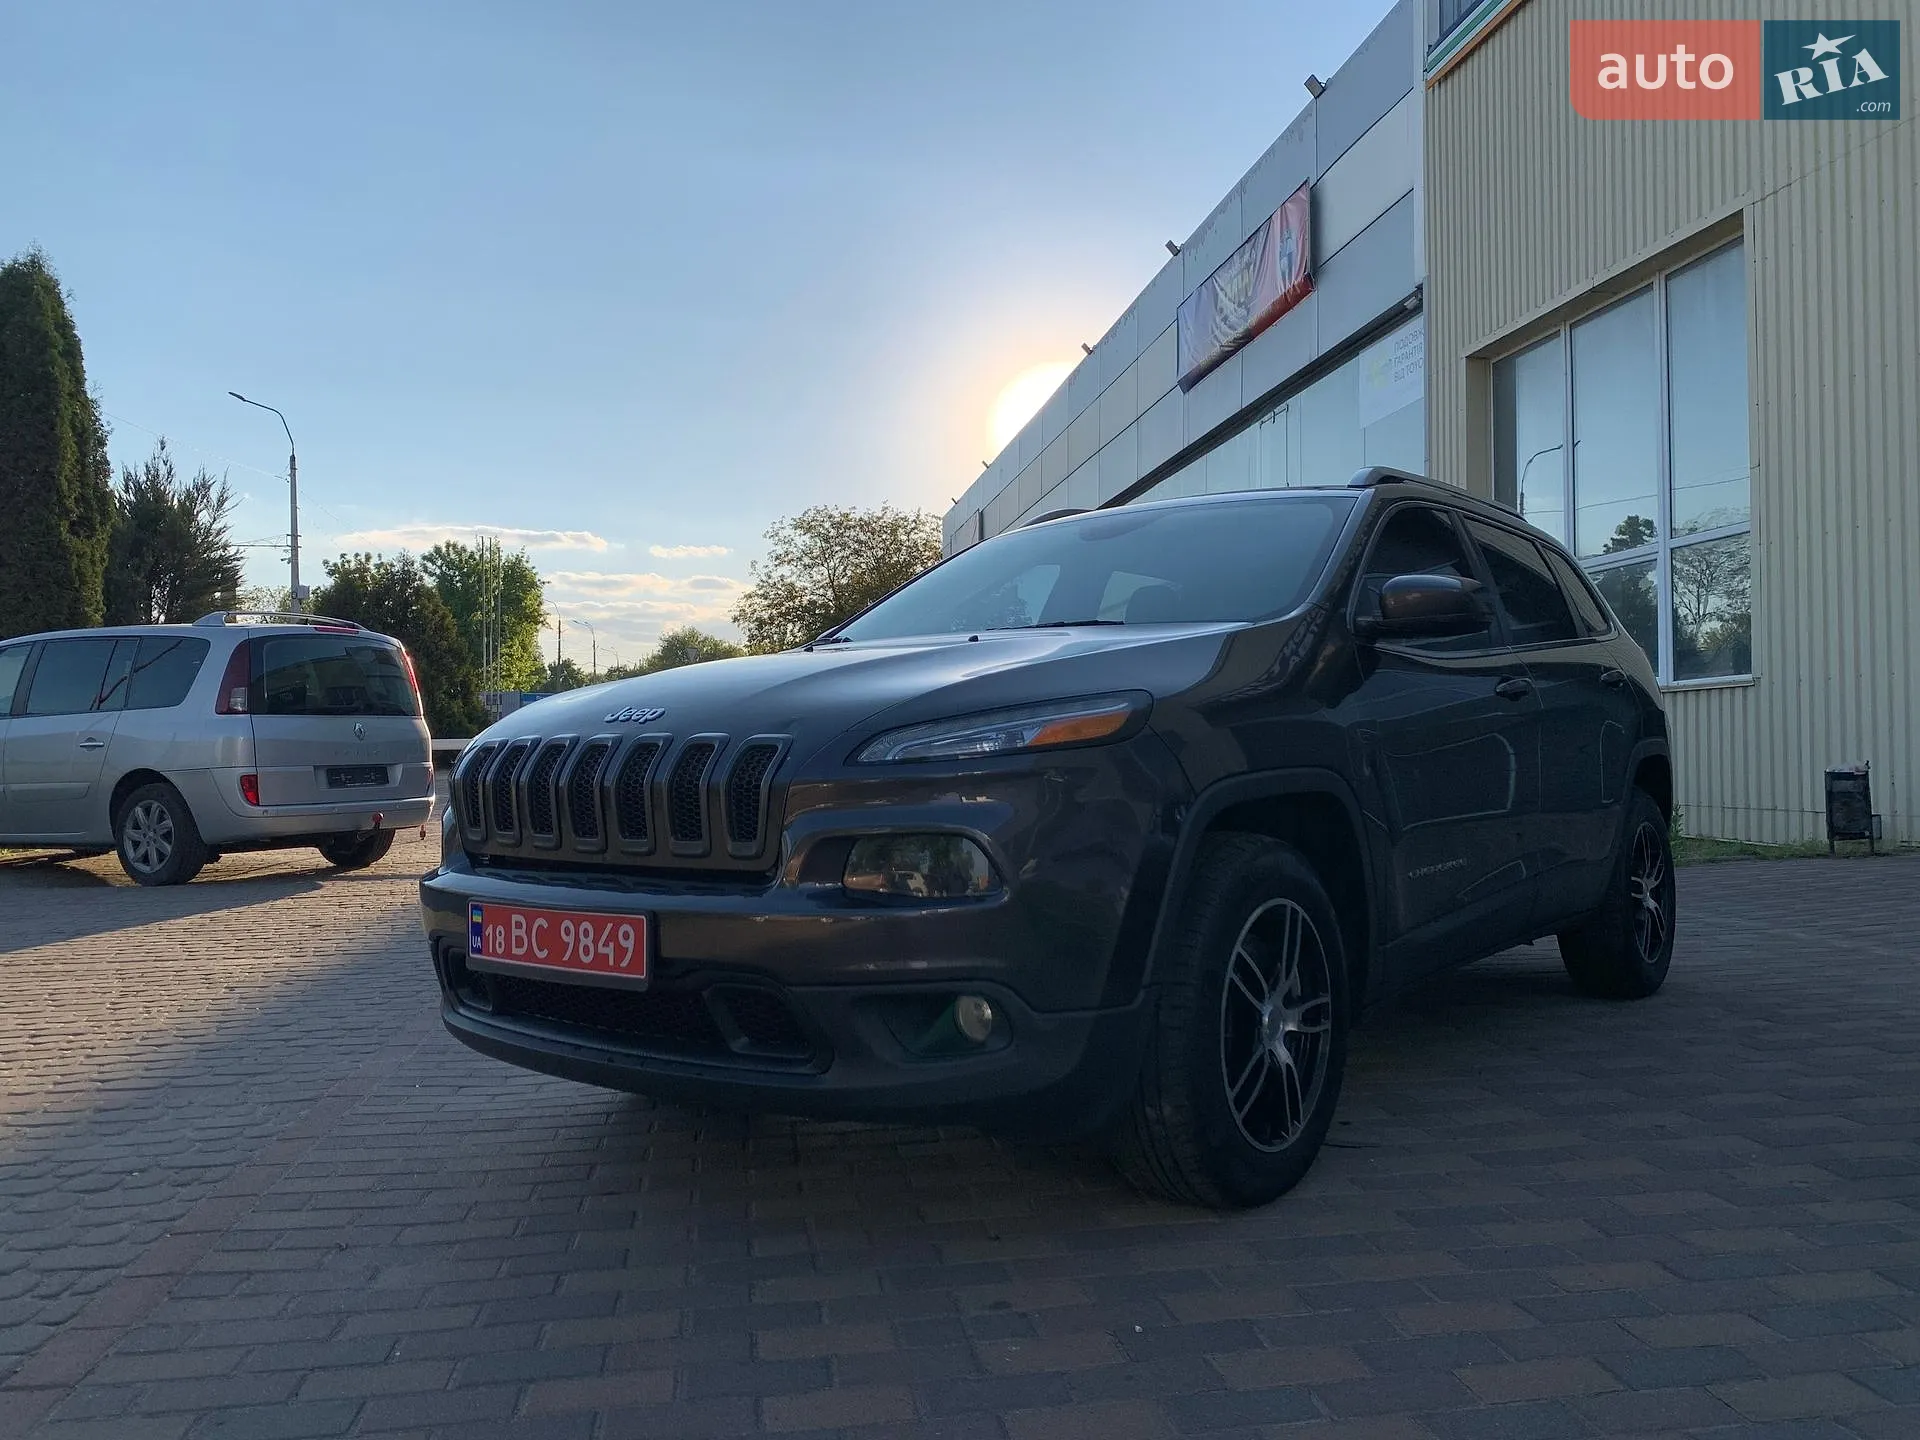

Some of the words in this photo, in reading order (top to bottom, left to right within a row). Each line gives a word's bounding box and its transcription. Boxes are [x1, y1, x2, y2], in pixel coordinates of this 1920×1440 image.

[604, 706, 666, 725] Jeep
[471, 936, 482, 949] UA
[485, 924, 505, 955] 18
[511, 914, 549, 959] BC
[560, 919, 635, 968] 9849
